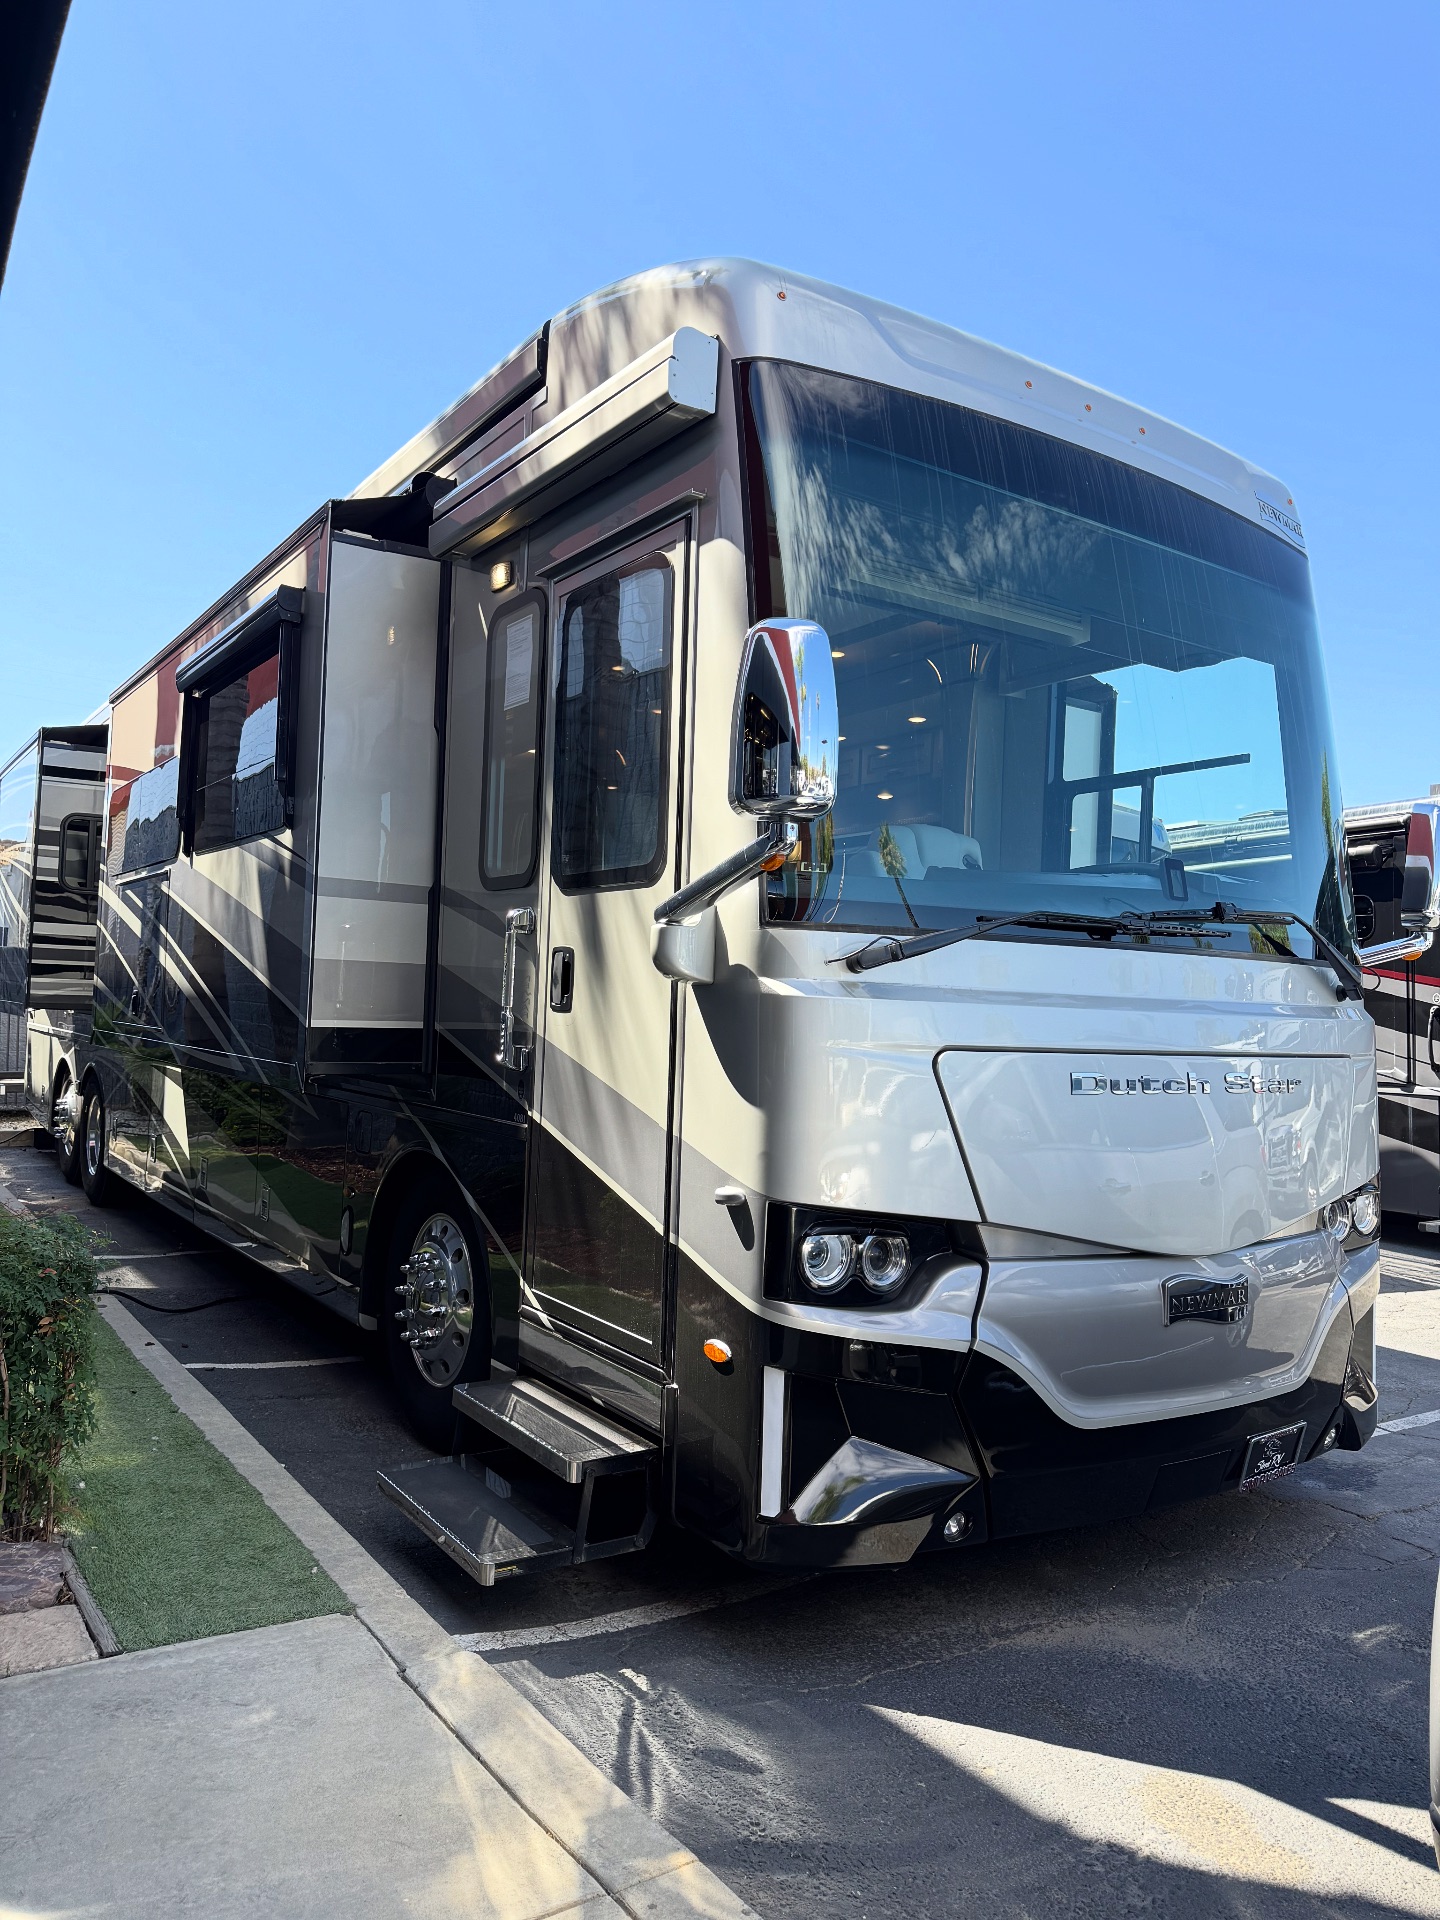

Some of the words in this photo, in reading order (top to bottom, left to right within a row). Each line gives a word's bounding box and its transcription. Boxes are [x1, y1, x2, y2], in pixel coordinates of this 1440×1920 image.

[1070, 1072, 1211, 1095] Dutch
[1224, 1072, 1302, 1095] Star
[1171, 1289, 1247, 1314] NEWMAR
